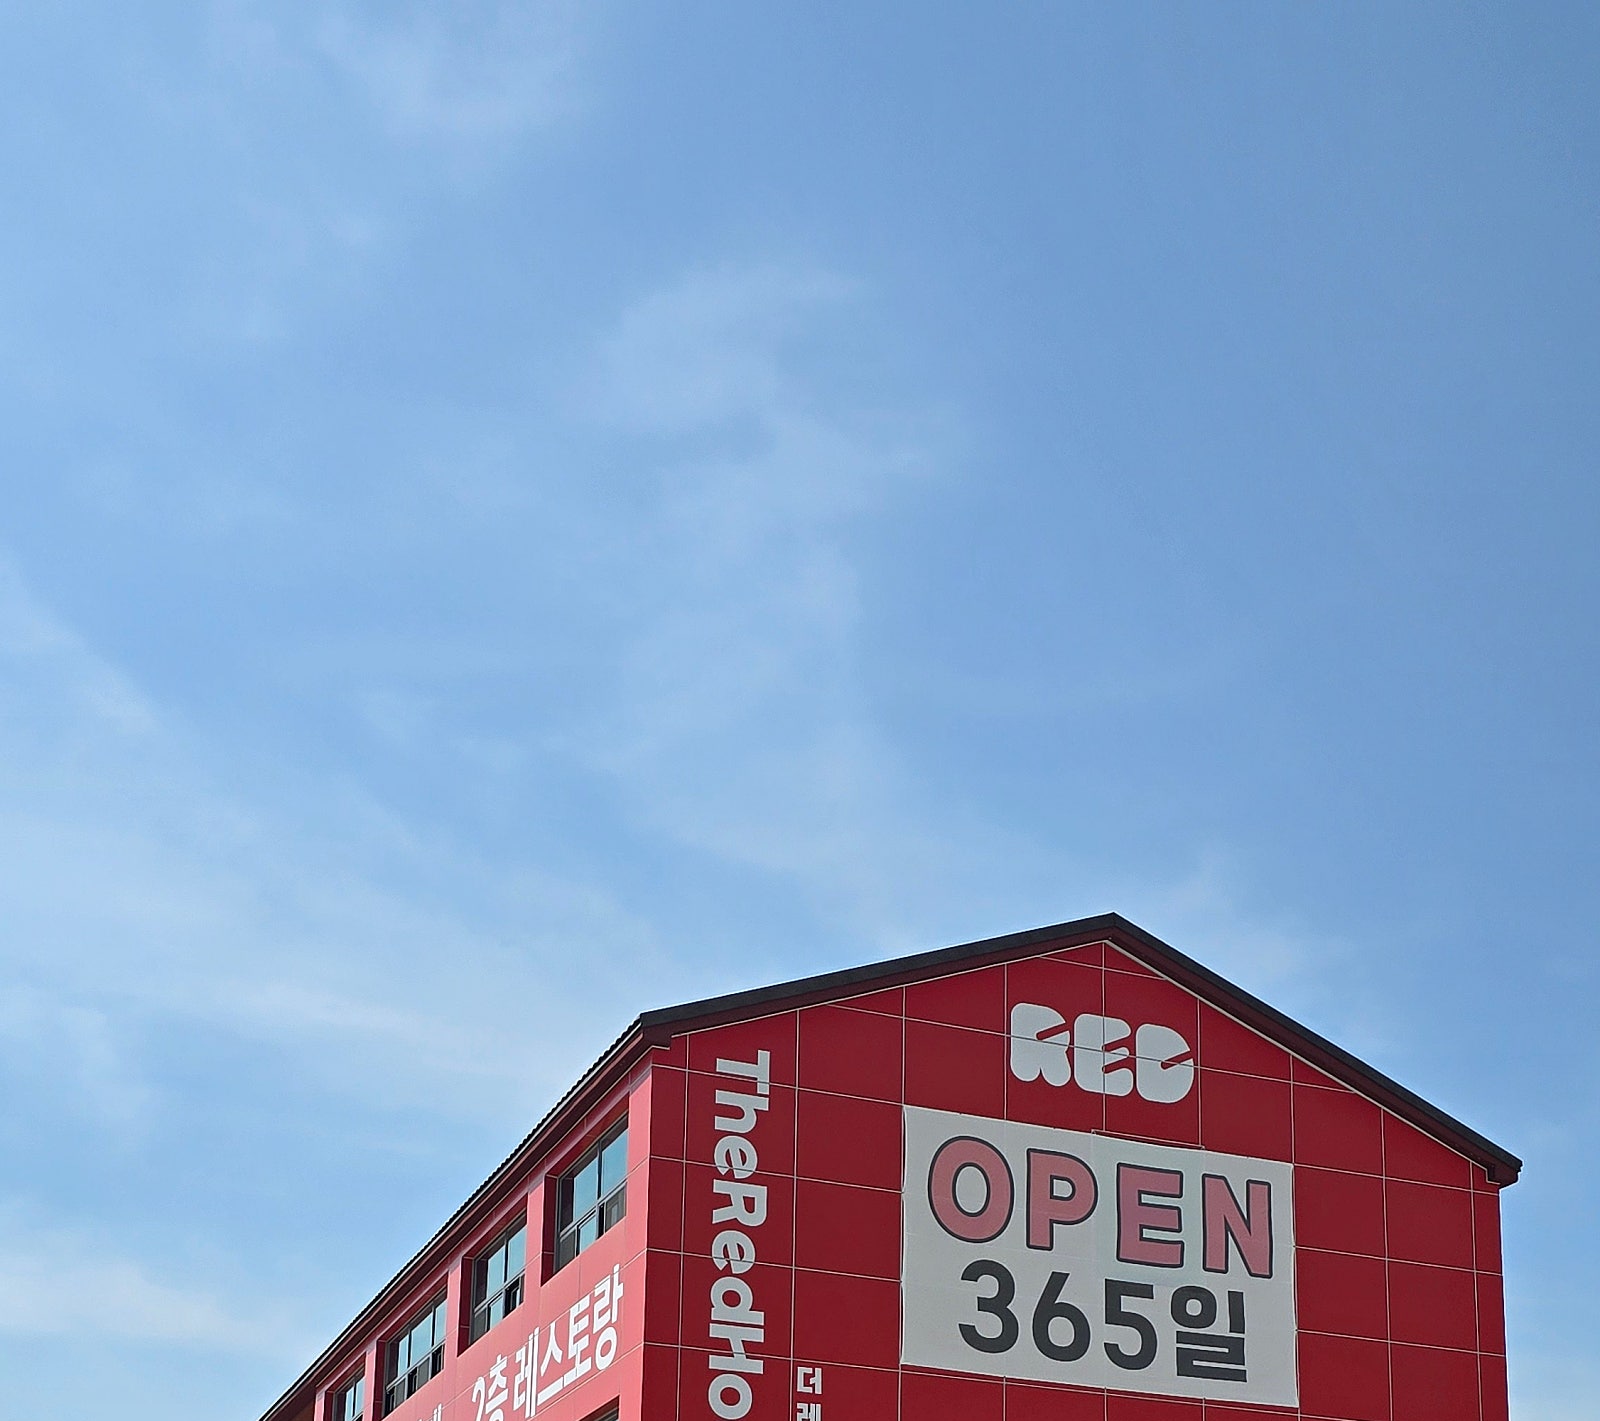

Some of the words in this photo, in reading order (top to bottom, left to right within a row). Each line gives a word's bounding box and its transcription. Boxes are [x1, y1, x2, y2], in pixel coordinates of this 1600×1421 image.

[1009, 1002, 1197, 1104] RED
[927, 1135, 1274, 1280] OPEN
[512, 1263, 625, 1419] 레스토랑
[958, 1259, 1248, 1384] 365일
